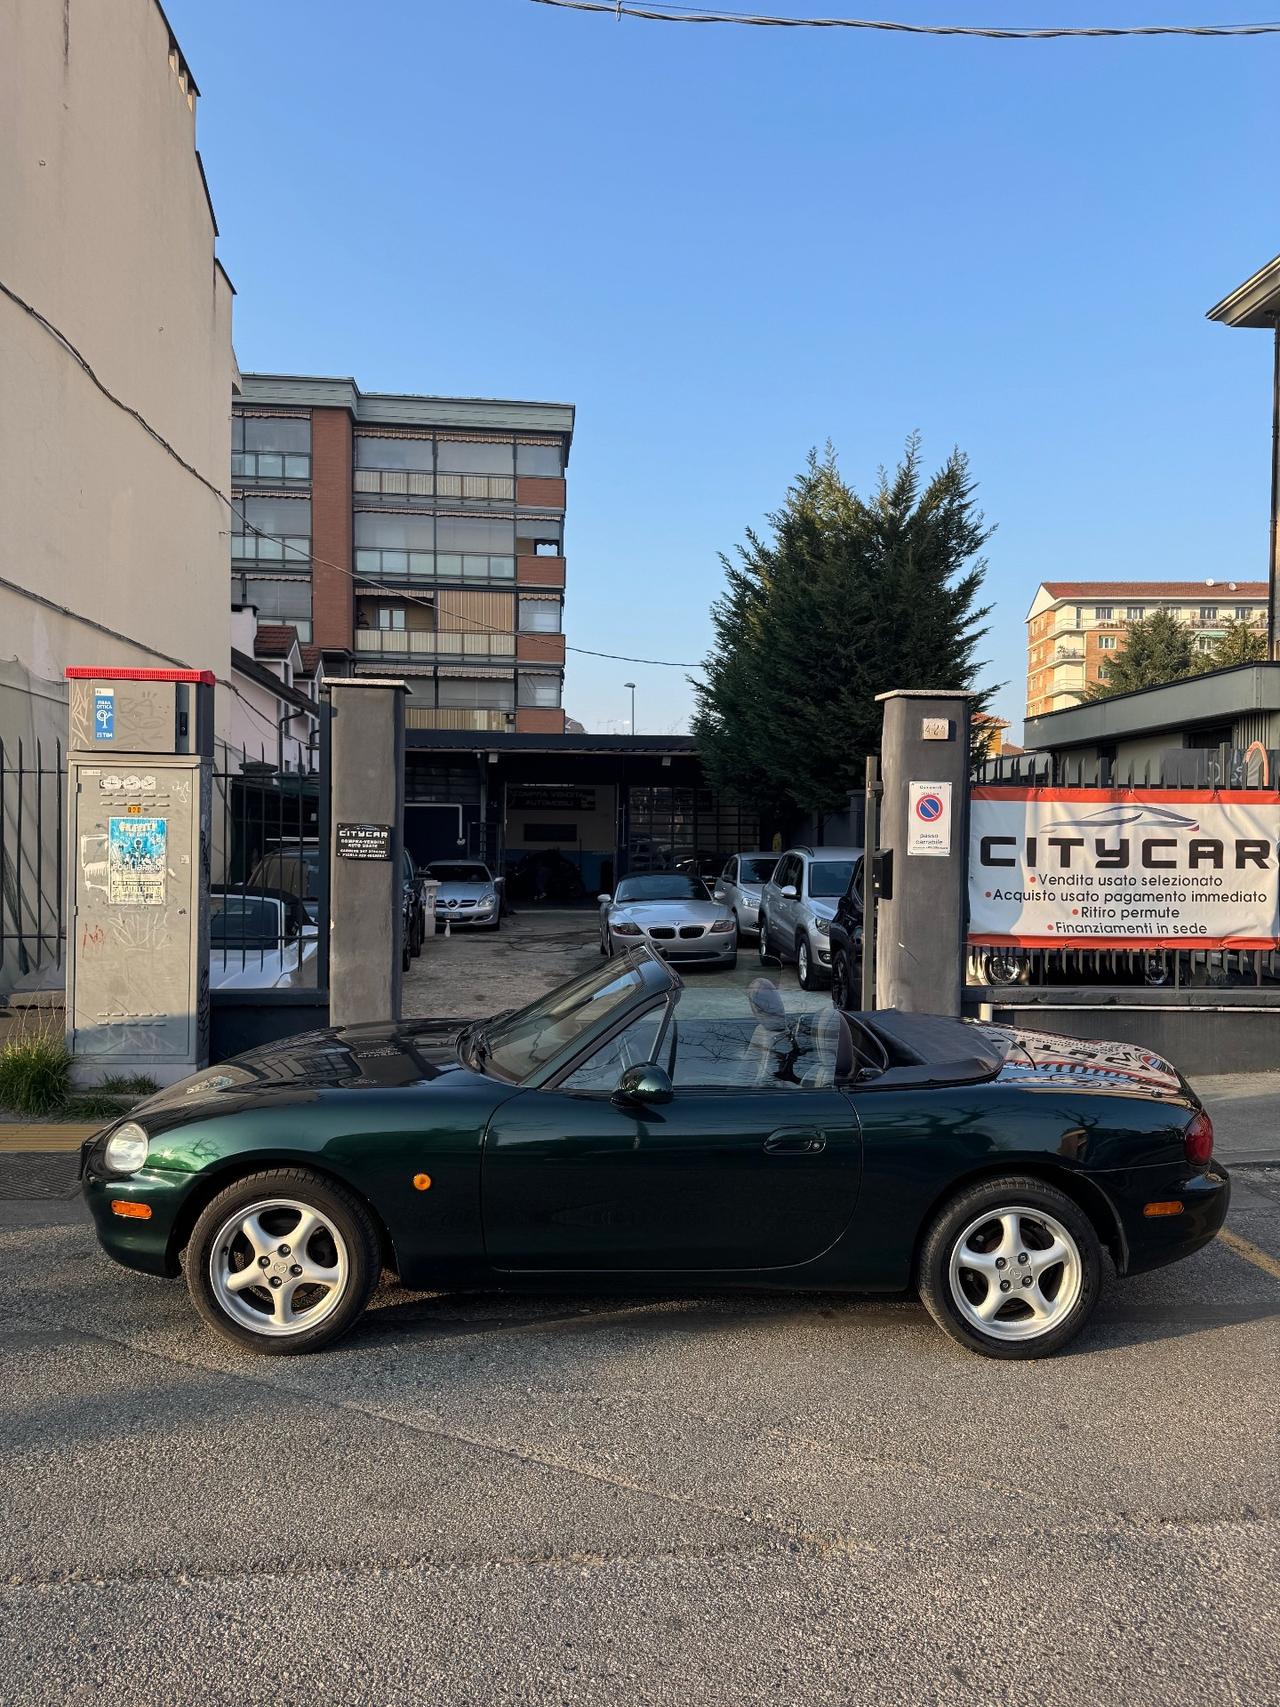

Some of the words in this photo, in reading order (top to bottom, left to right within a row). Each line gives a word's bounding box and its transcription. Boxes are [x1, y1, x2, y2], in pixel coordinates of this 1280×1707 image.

[339, 830, 388, 838] CITYCAR
[980, 836, 1271, 869] CITYCAR
[1038, 874, 1093, 886] Vendita
[1098, 876, 1137, 887] usato
[1141, 875, 1223, 887] selezionato
[993, 889, 1056, 903] Acquisto
[1060, 890, 1100, 902] usato
[1104, 891, 1187, 905] pagamento
[1191, 891, 1267, 903] immediato
[1081, 906, 1116, 918] Ritiro
[1120, 907, 1180, 920] permute
[1055, 922, 1152, 934] Finanziamenti
[1156, 923, 1169, 934] in
[1173, 923, 1207, 934] sede
